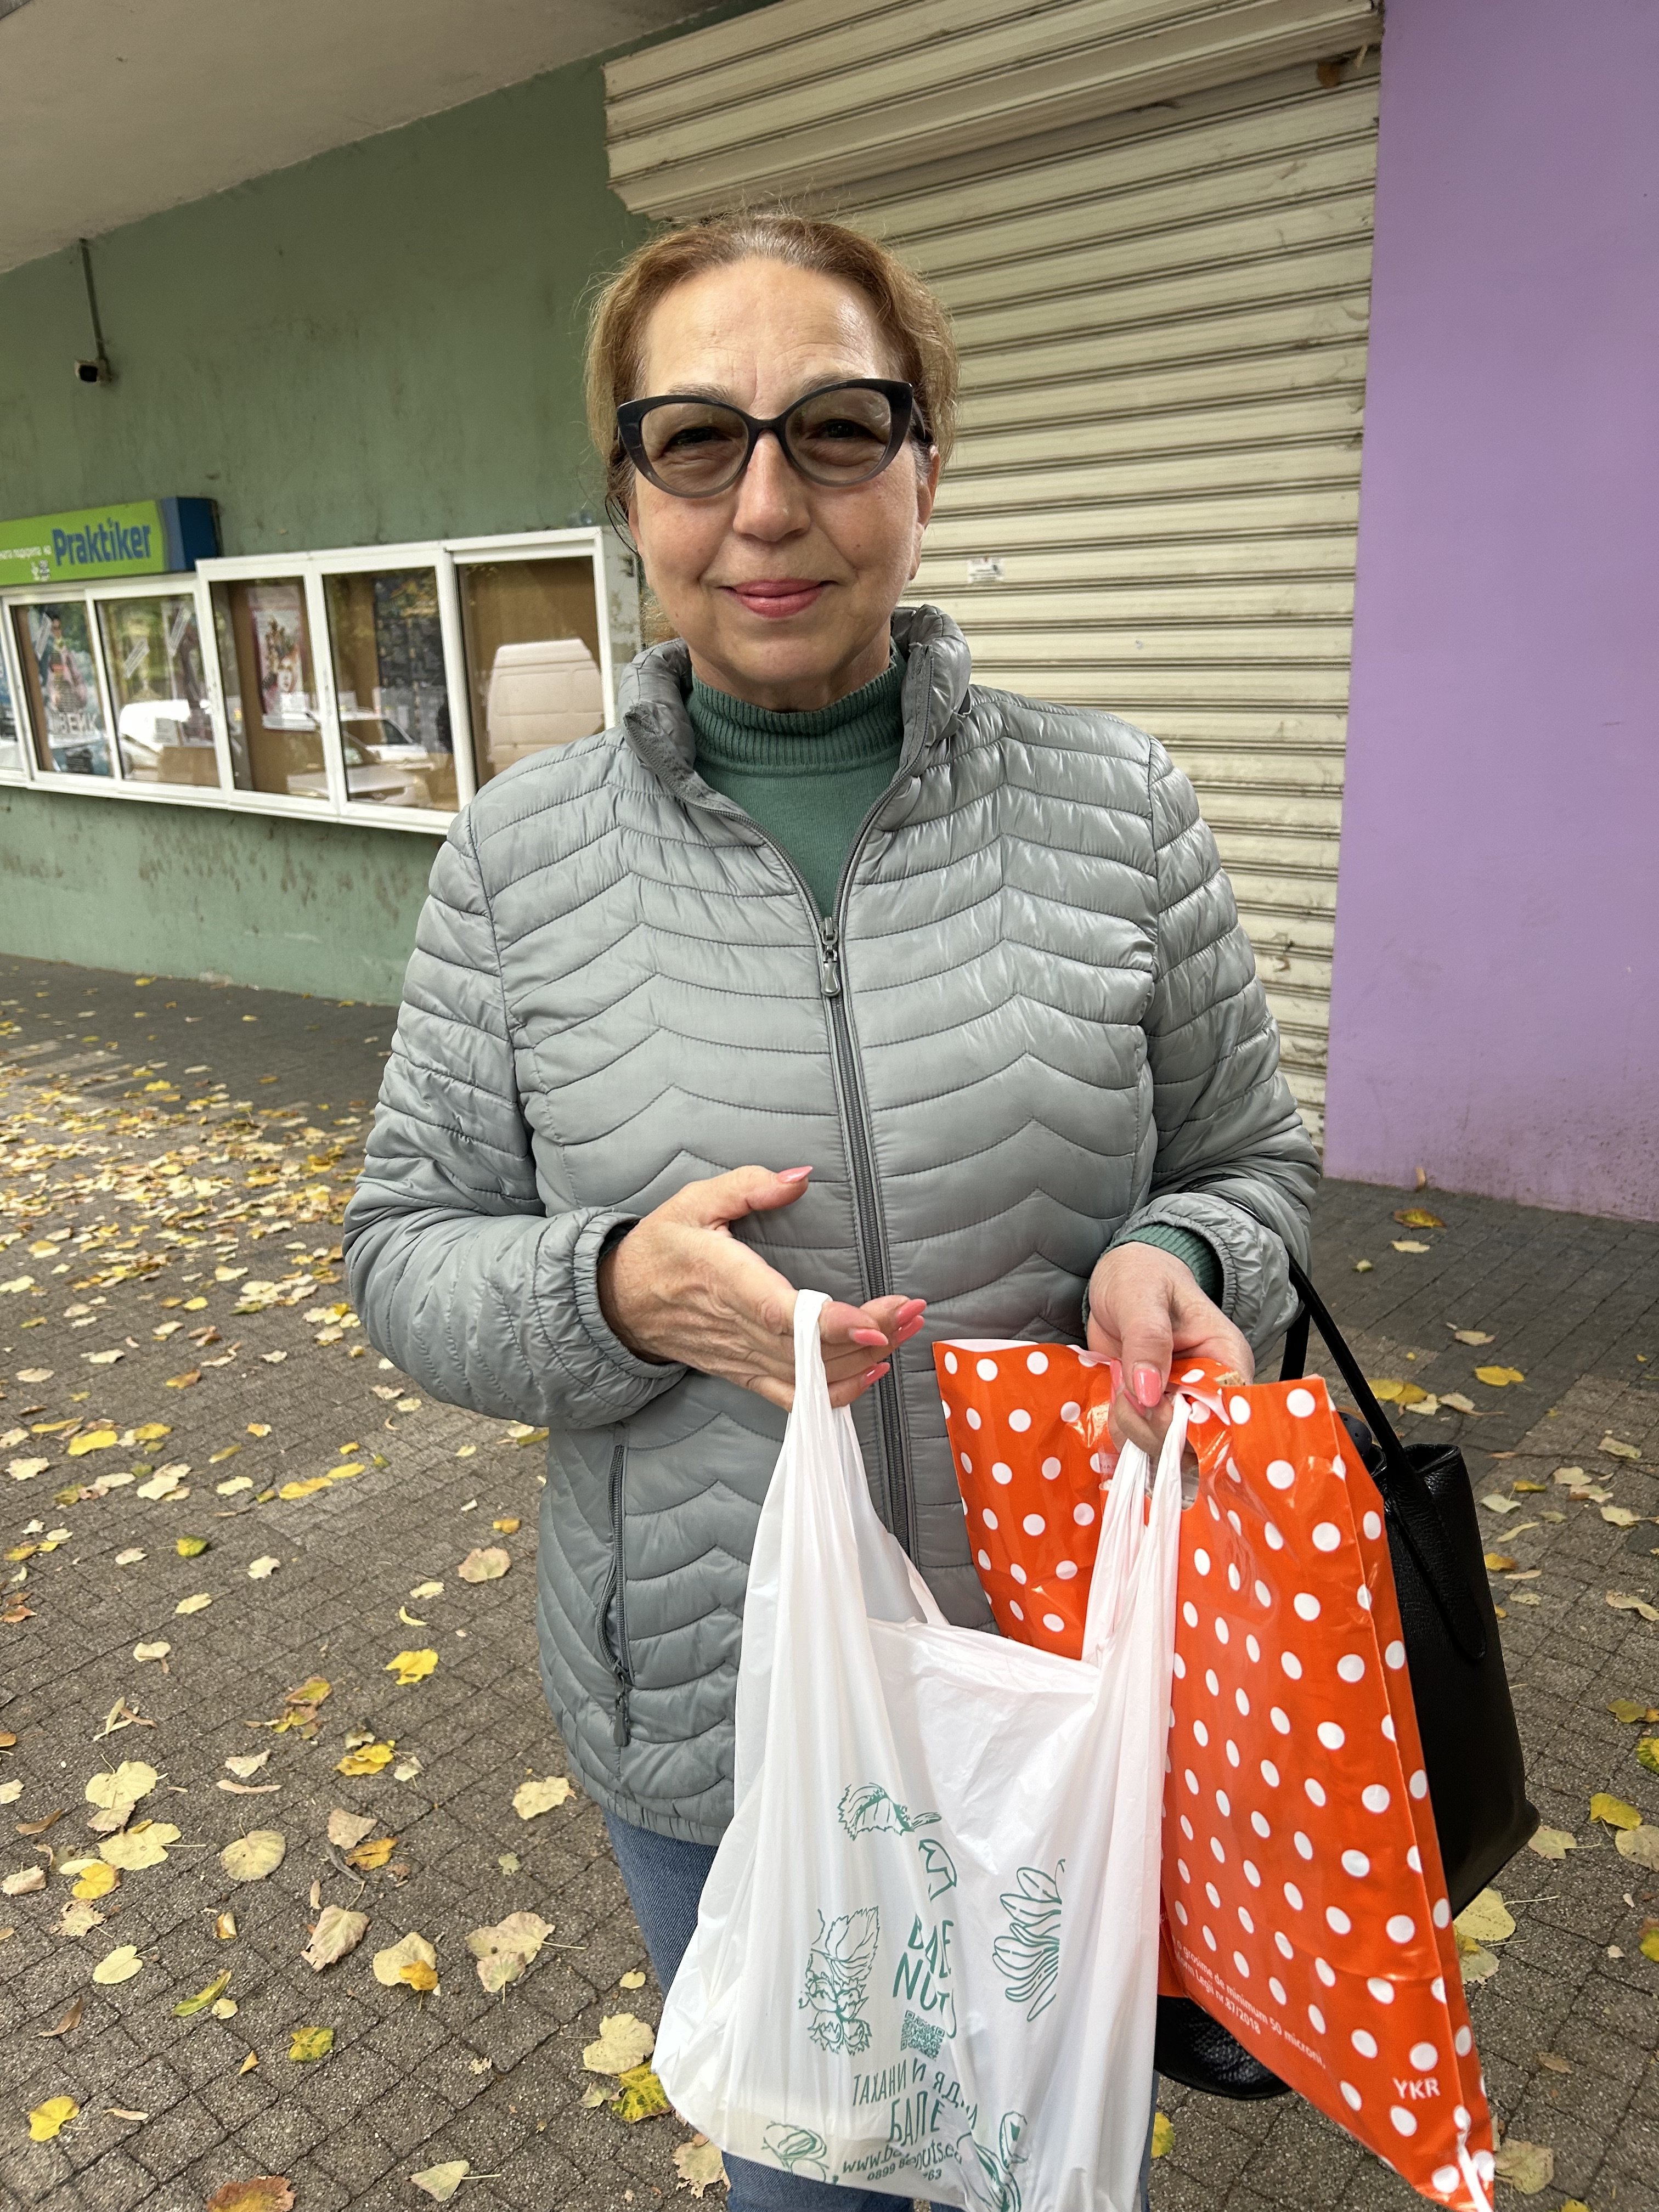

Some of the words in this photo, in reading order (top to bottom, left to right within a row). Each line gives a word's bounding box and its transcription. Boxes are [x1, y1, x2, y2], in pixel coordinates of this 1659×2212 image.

[53, 517, 151, 566] Praktiker
[1183, 1946, 1213, 1979] grosime
[1214, 1973, 1225, 1990] de
[1225, 1984, 1268, 2024] minimum
[1269, 2016, 1282, 2035] 50
[1195, 1969, 1214, 1995] Legii
[853, 2058, 906, 2107] ТАХАНИ
[912, 2057, 927, 2084] И
[932, 2070, 978, 2130] ЯДИ
[1392, 2077, 1441, 2100] YKR
